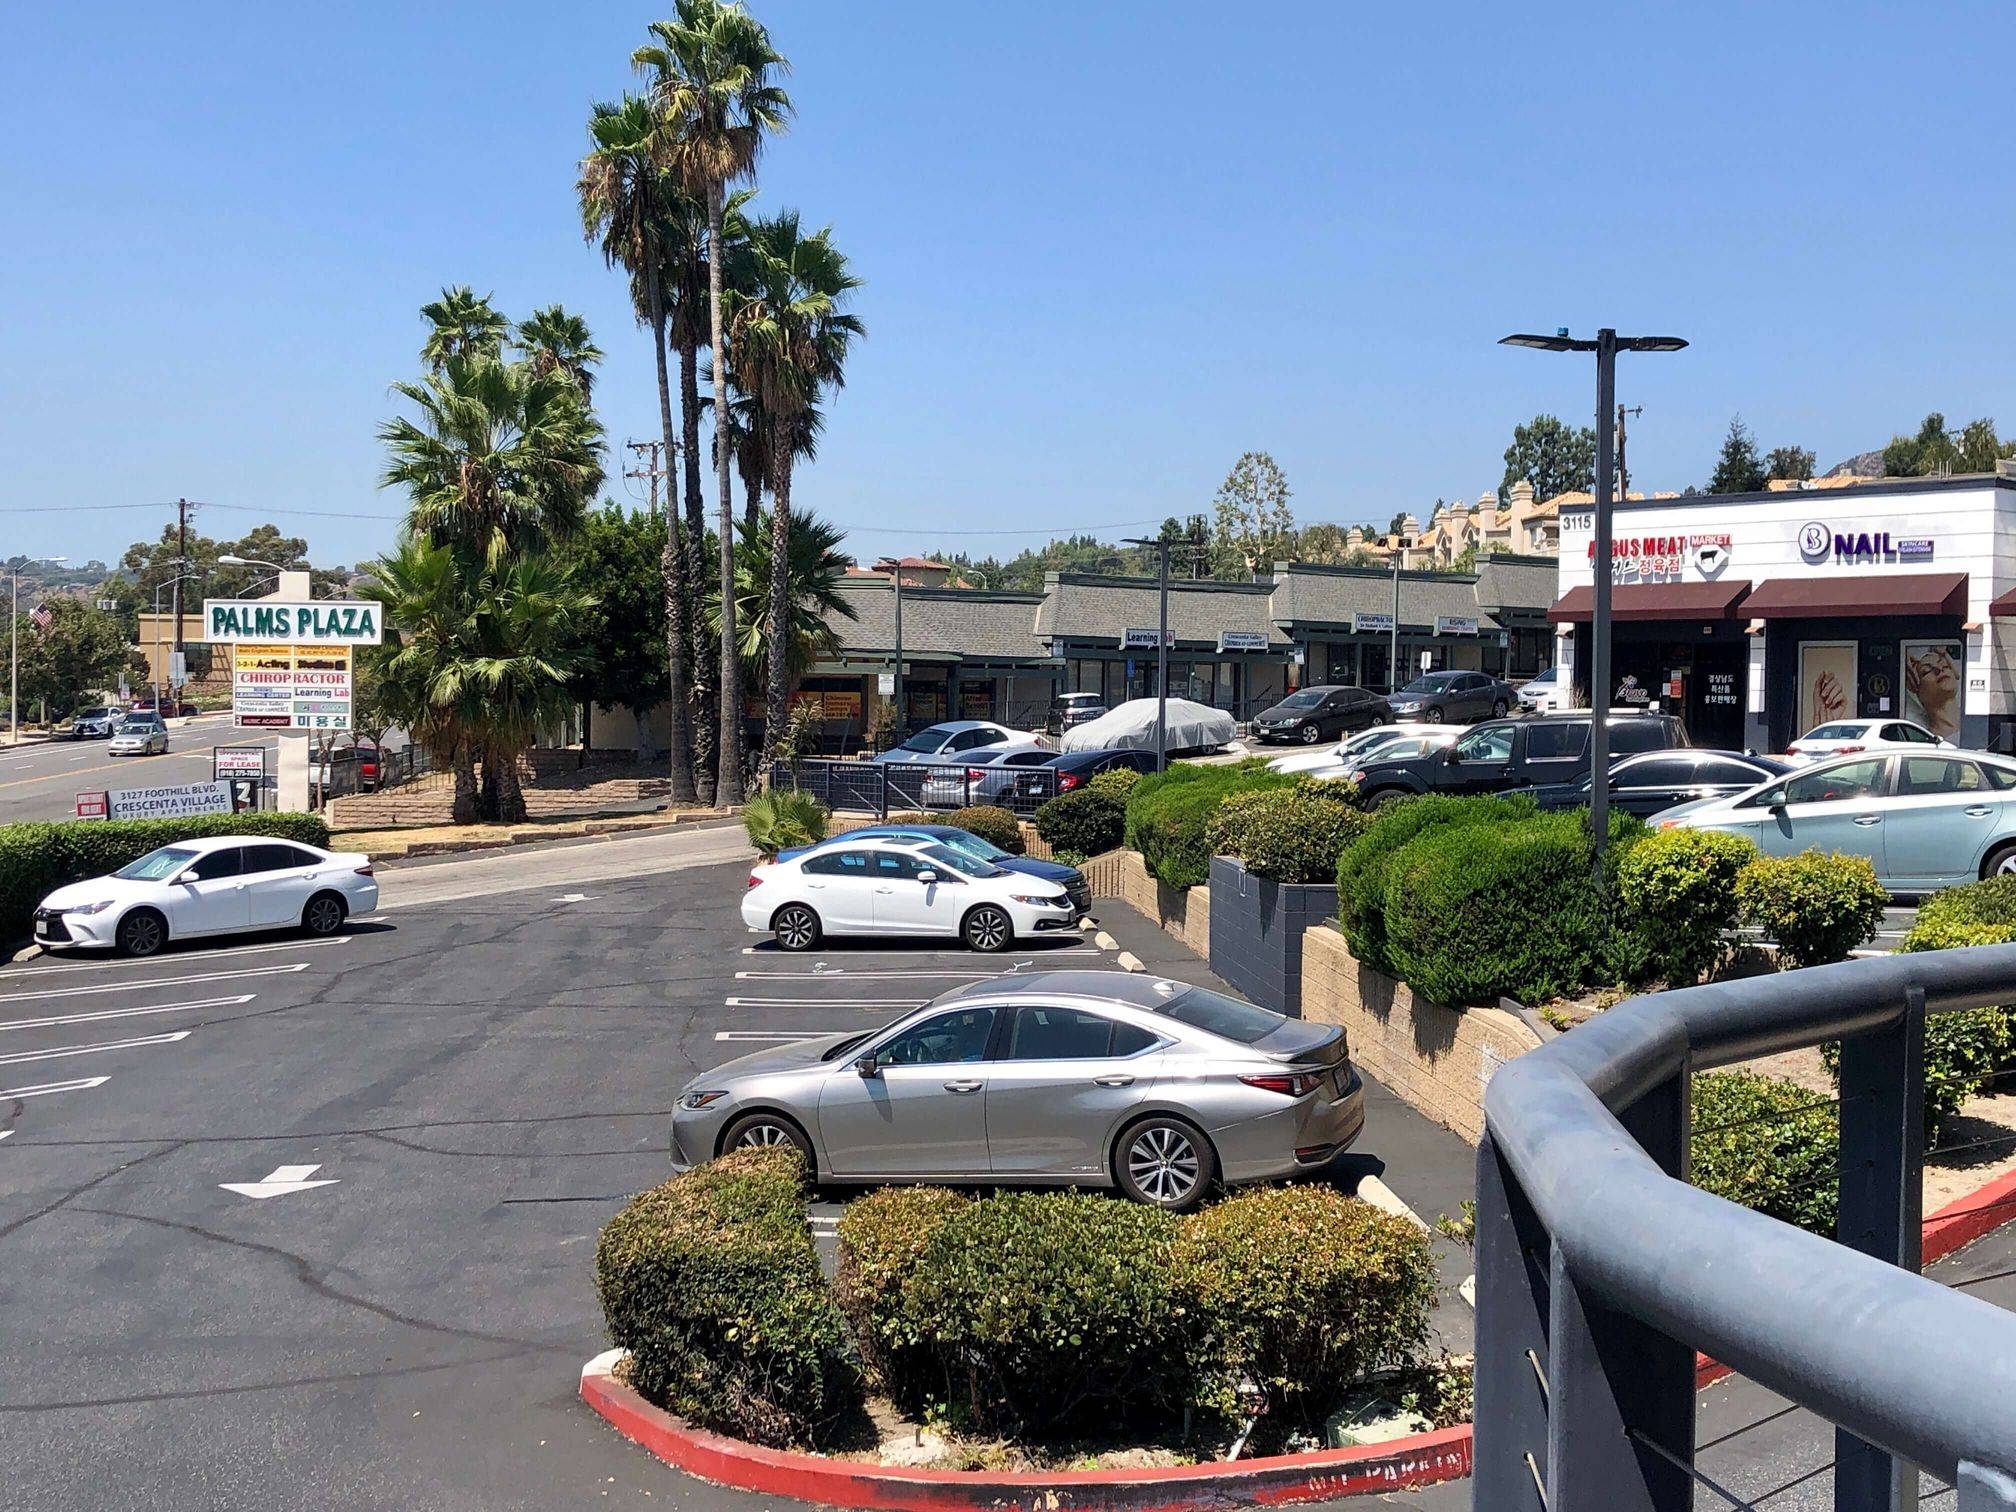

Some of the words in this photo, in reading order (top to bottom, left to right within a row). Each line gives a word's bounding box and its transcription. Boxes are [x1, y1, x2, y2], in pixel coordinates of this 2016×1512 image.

[1563, 516, 1591, 530] 3115
[1588, 539, 1640, 558] AGUS
[1643, 536, 1686, 555] MEAT
[1691, 535, 1729, 545] MARKET
[1835, 532, 1897, 554] NAIL
[1639, 558, 1681, 575] 정육점
[212, 607, 291, 637] PALMS
[297, 608, 376, 637] PLAZA
[1127, 632, 1158, 644] Learning
[241, 673, 345, 684] CHIROPRACTOR
[294, 688, 332, 698] Learning
[334, 688, 350, 697] Lab
[120, 791, 142, 800] 3127
[145, 786, 190, 798] FOOTHILL
[192, 784, 219, 794] BLVD.
[114, 798, 178, 813] CRESCENTA
[180, 794, 226, 807] VILLAGE
